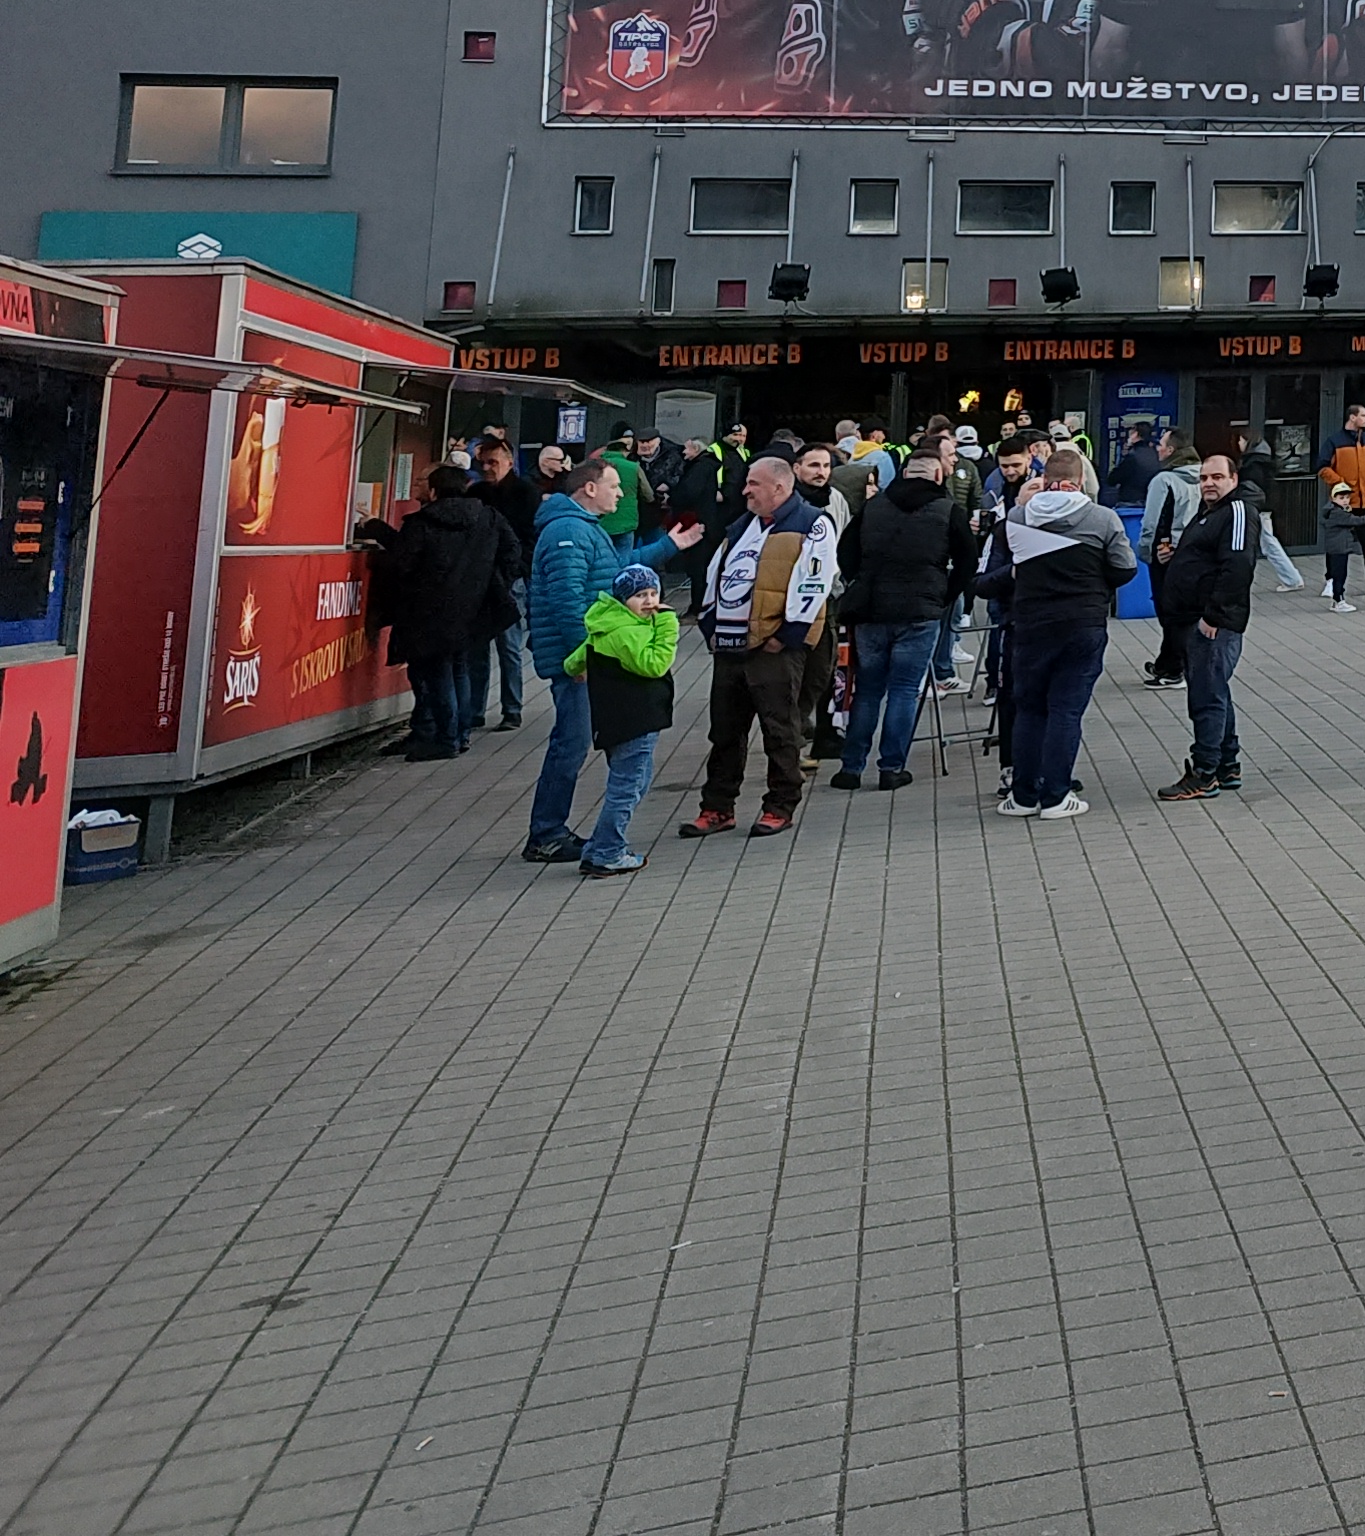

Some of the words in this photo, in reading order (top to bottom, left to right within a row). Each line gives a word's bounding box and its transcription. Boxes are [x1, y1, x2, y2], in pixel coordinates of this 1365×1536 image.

[618, 32, 662, 42] TIPOS
[924, 78, 1053, 99] JEDNO
[1067, 76, 1260, 105] MUŽSTVO,
[658, 344, 778, 367] ENTRANCE
[787, 343, 801, 364] B
[859, 342, 928, 363] VSTUP
[935, 341, 949, 362] B
[1003, 339, 1115, 361] ENTRANCE
[1122, 338, 1136, 359] B
[1218, 335, 1282, 357] VSTUP
[1288, 335, 1302, 355] B
[459, 347, 537, 370] VSTUP
[544, 347, 560, 369] B
[316, 572, 364, 621] FANDÍME
[801, 596, 815, 614] 7
[223, 651, 261, 706] ŠARIŠ
[290, 659, 300, 699] S
[300, 640, 338, 694] ISKROU
